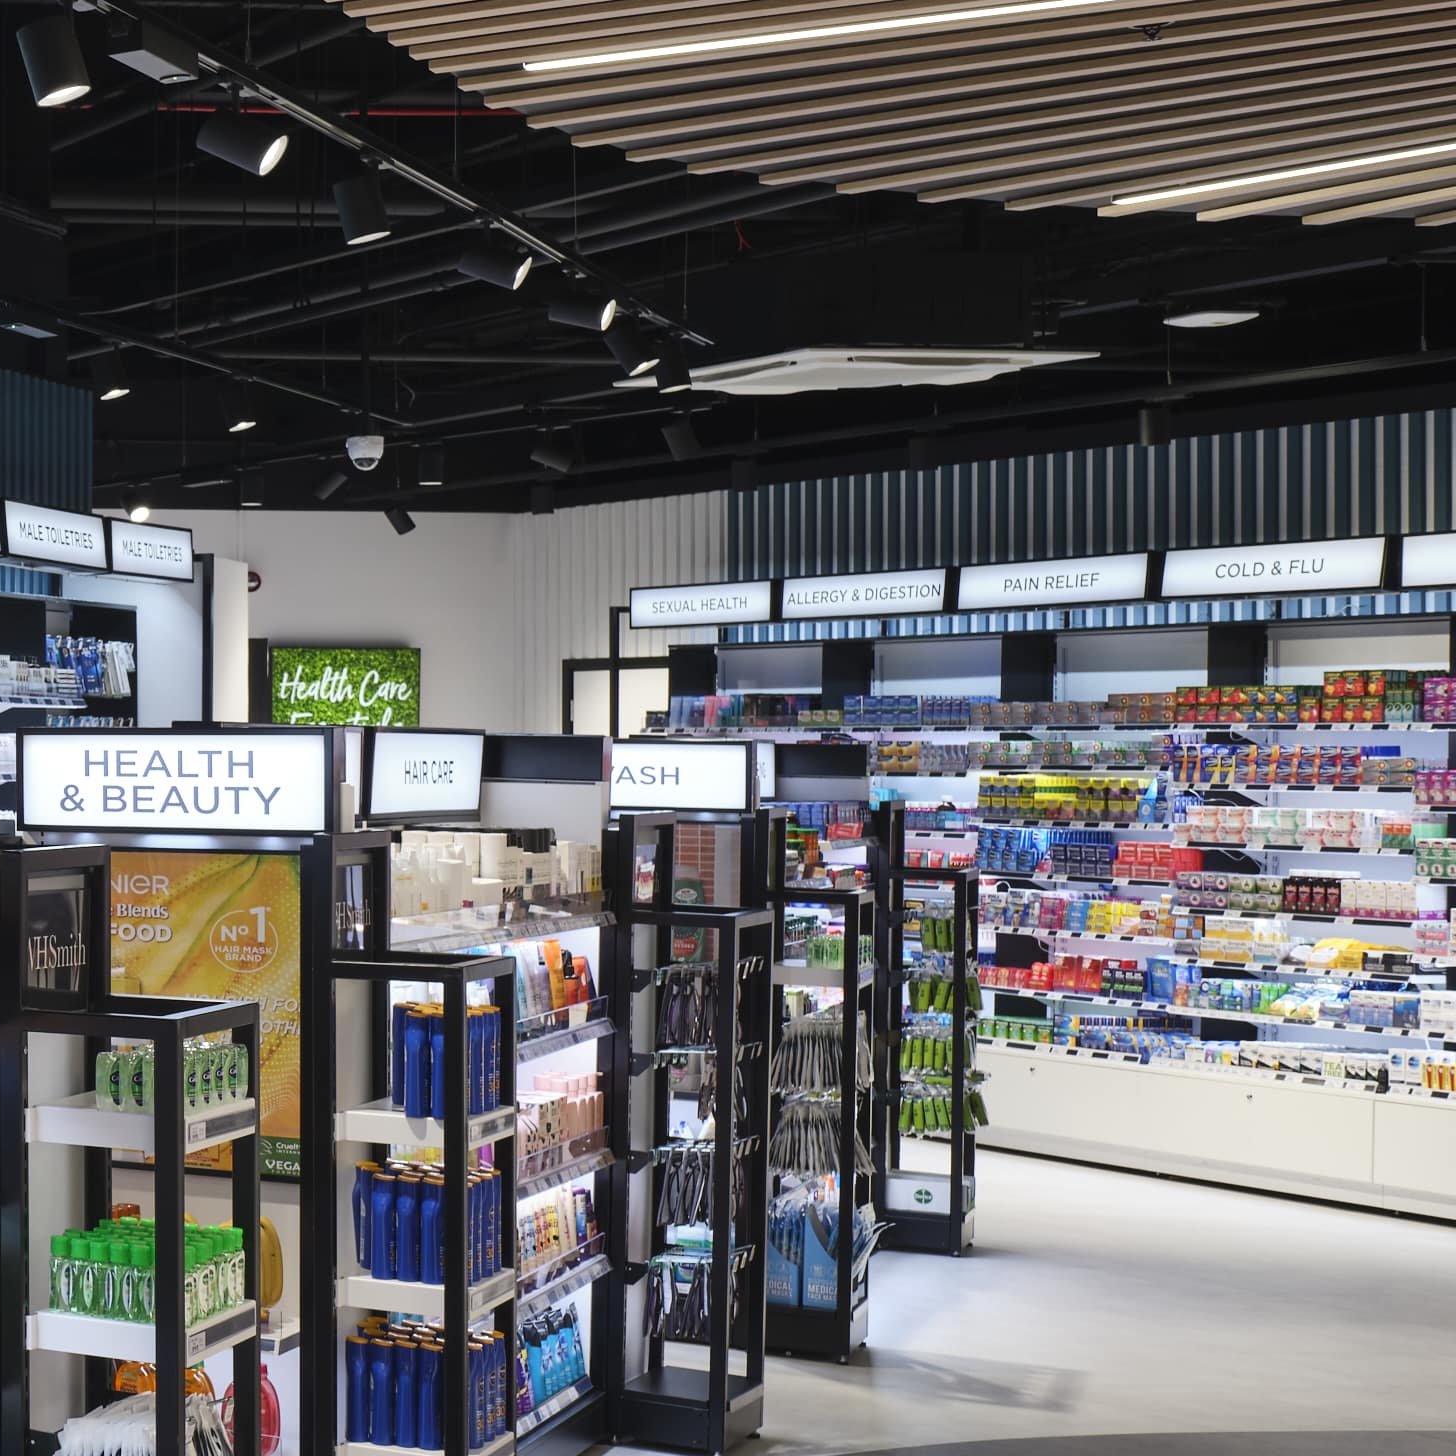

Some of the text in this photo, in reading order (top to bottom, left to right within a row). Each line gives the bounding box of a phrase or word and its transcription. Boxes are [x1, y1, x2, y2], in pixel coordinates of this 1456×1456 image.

[19, 521, 94, 550] MALE TOILETRIES
[122, 539, 183, 563] MALE TOILETRIES
[1215, 558, 1326, 579] COLD & FLU
[1003, 572, 1100, 593] PAIN RELIEF
[652, 596, 748, 614] SEXUAL HEALTH
[787, 583, 942, 606] ALLERGY & DIGESTION
[279, 665, 413, 708] Health Care
[84, 749, 254, 779] HEALTH
[404, 759, 455, 785] HAIR CARE
[611, 765, 680, 786] ASH
[59, 784, 281, 816] & BEAUTY
[116, 904, 169, 919] Blends
[224, 953, 263, 962] BRAND
